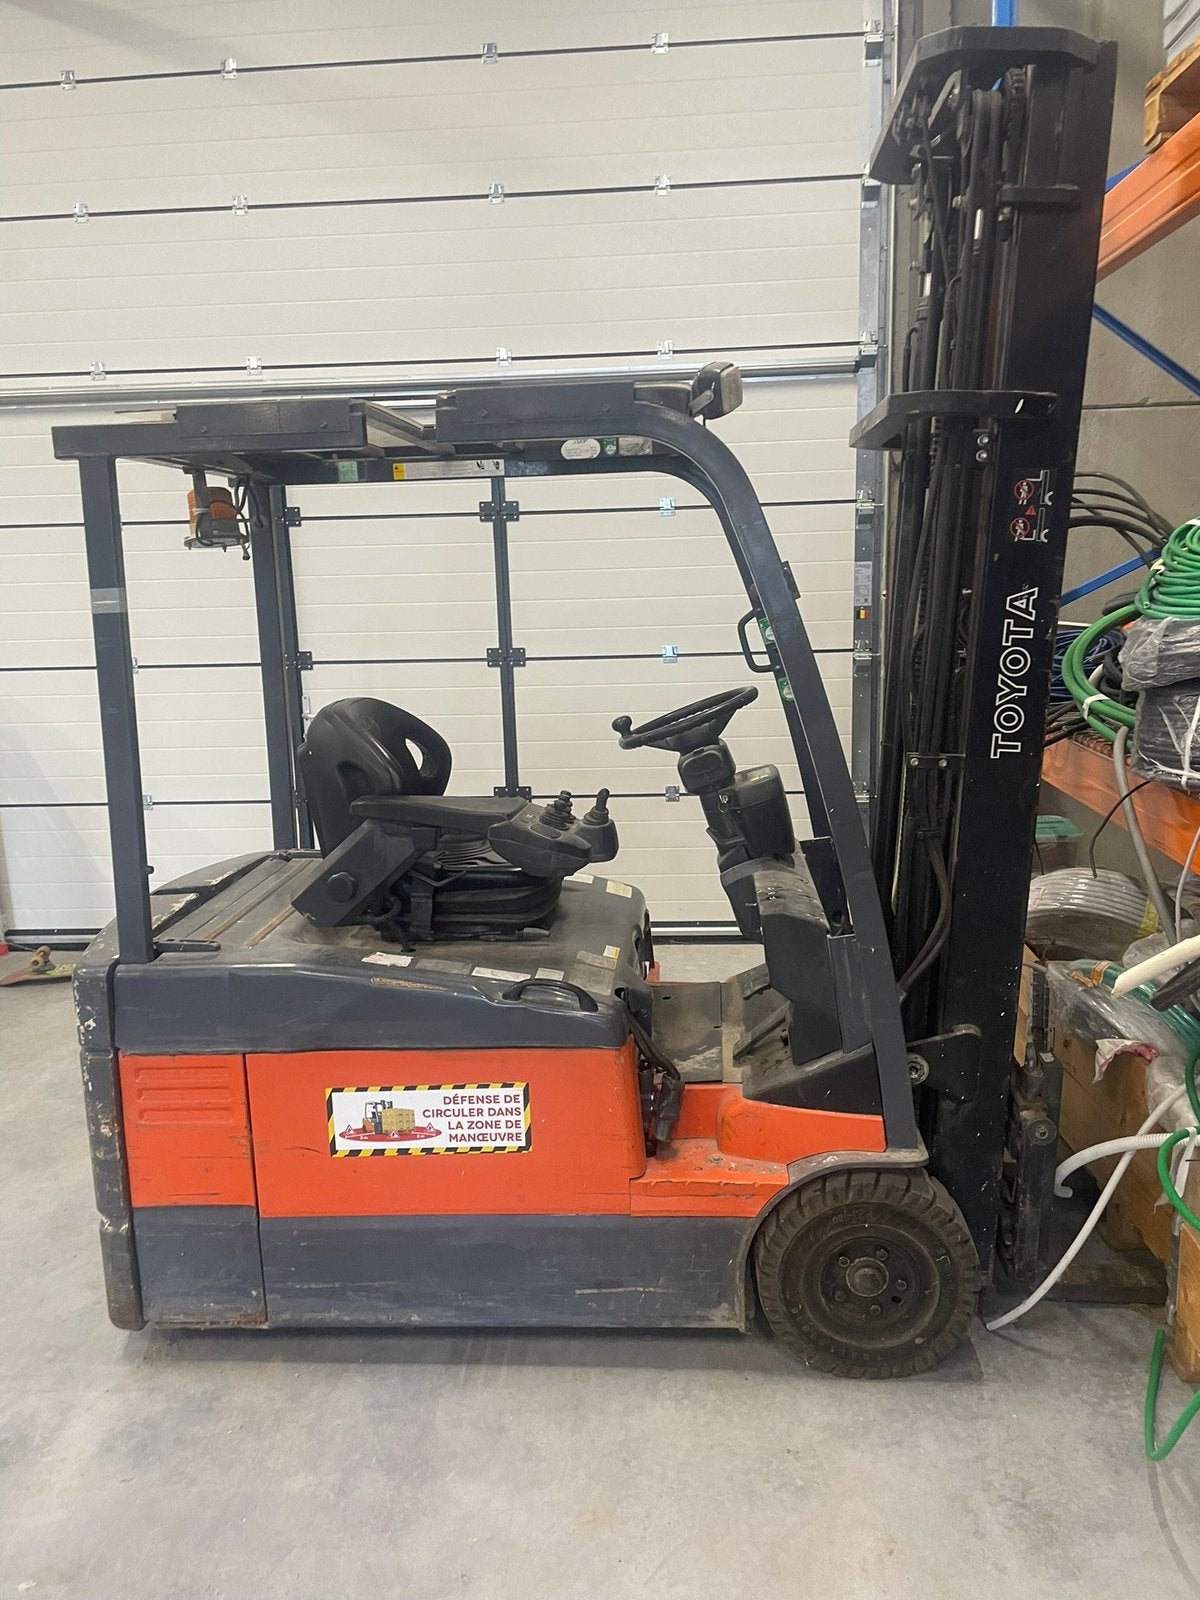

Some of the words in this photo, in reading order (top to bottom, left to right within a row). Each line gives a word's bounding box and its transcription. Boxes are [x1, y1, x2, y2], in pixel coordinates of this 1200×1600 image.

[990, 587, 1039, 759] TOYOTA
[443, 1093, 500, 1105] DÉFENSE
[504, 1094, 521, 1104] DE
[422, 1107, 484, 1118] CIRCULER
[488, 1107, 522, 1117] DANS
[447, 1121, 464, 1130] LA
[467, 1120, 502, 1130] ZONE
[505, 1120, 522, 1129] DE
[448, 1132, 523, 1143] MANŒUVRE
